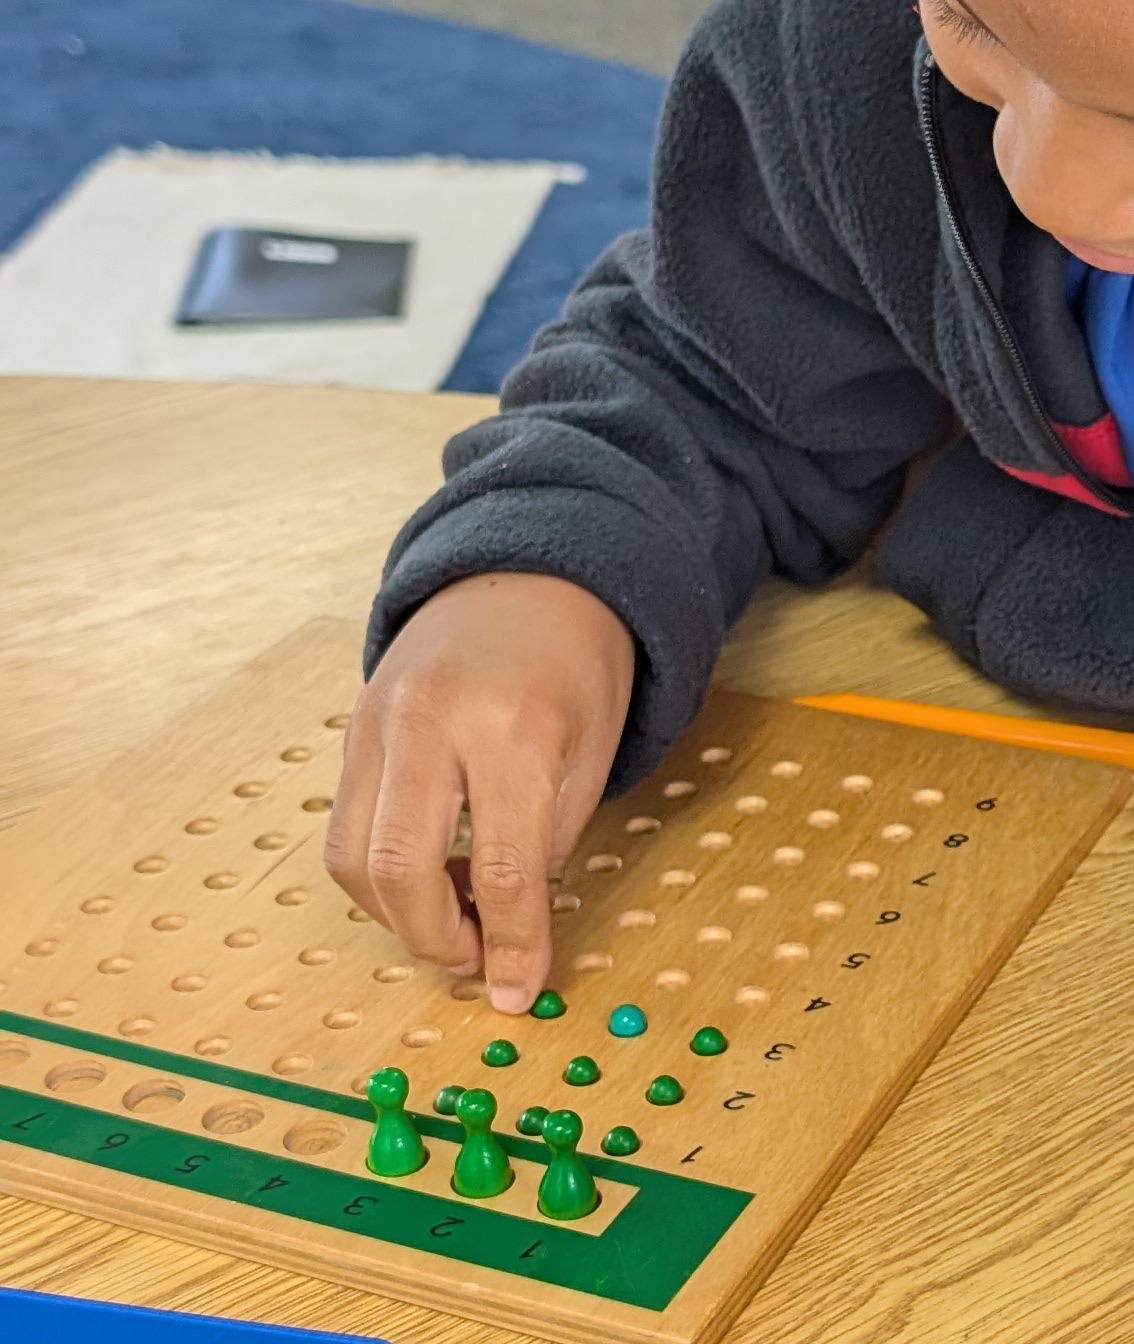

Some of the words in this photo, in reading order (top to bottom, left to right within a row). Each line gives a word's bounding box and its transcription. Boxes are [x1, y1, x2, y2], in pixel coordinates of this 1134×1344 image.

[975, 797, 998, 812] 9
[943, 833, 969, 848] 8
[912, 871, 937, 887] 7
[875, 910, 901, 925] 6
[841, 952, 871, 970] 5
[804, 996, 831, 1012] 4
[764, 1043, 796, 1061] 3
[723, 1091, 756, 1110] 2
[12, 1112, 46, 1131] 7
[98, 1132, 131, 1151] 6
[680, 1145, 704, 1164] 1
[174, 1154, 210, 1174] 5
[258, 1174, 290, 1192] 4
[343, 1194, 380, 1216] 3
[429, 1215, 467, 1238] 2
[518, 1239, 544, 1260] 1
